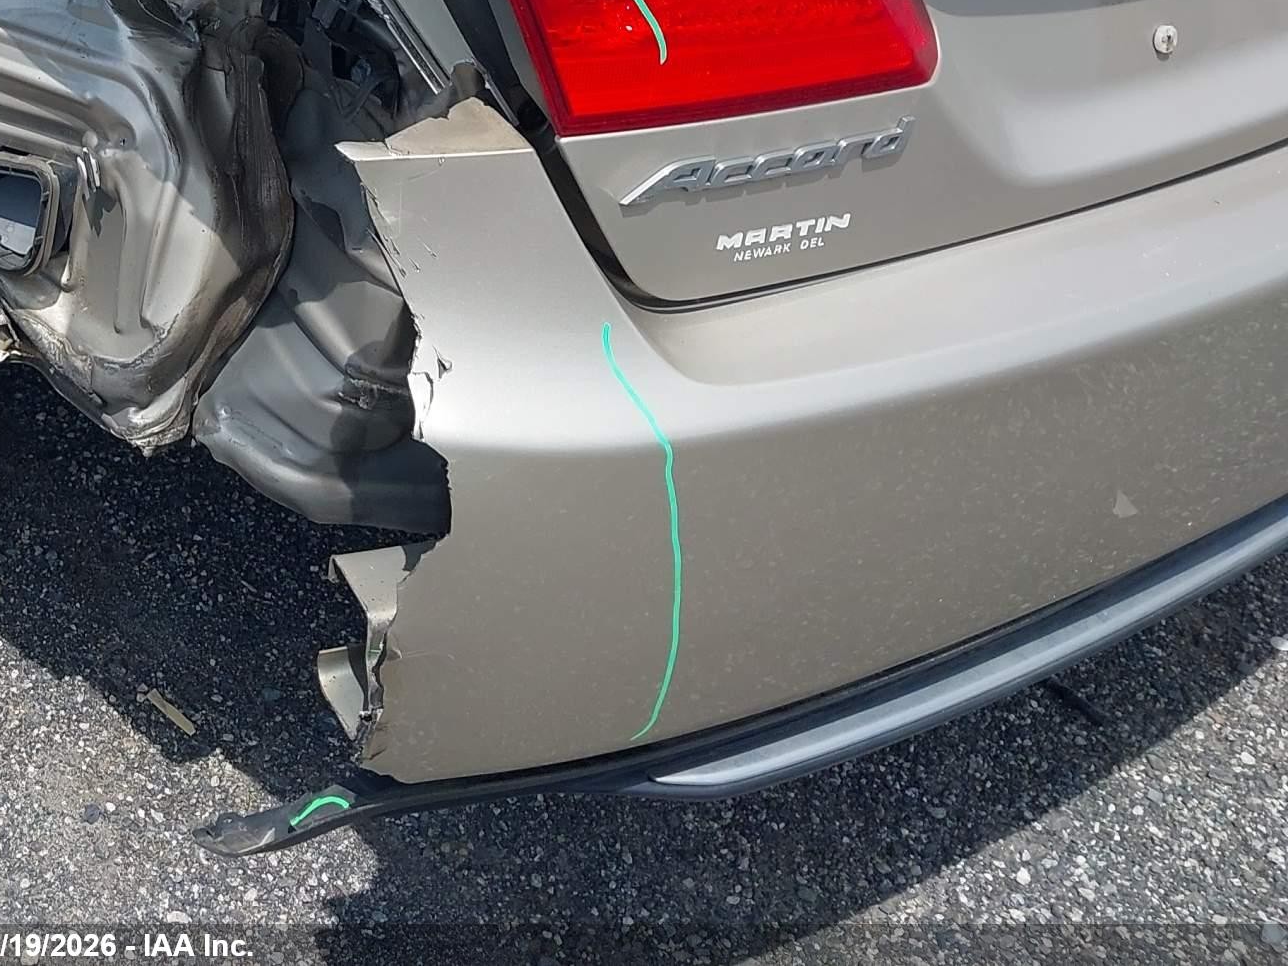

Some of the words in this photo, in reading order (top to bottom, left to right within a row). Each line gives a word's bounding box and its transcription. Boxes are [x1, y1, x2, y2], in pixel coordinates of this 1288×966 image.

[618, 115, 916, 207] Accord
[716, 213, 852, 252] MARTIN
[733, 242, 791, 263] NEWARK
[799, 237, 825, 251] DEL
